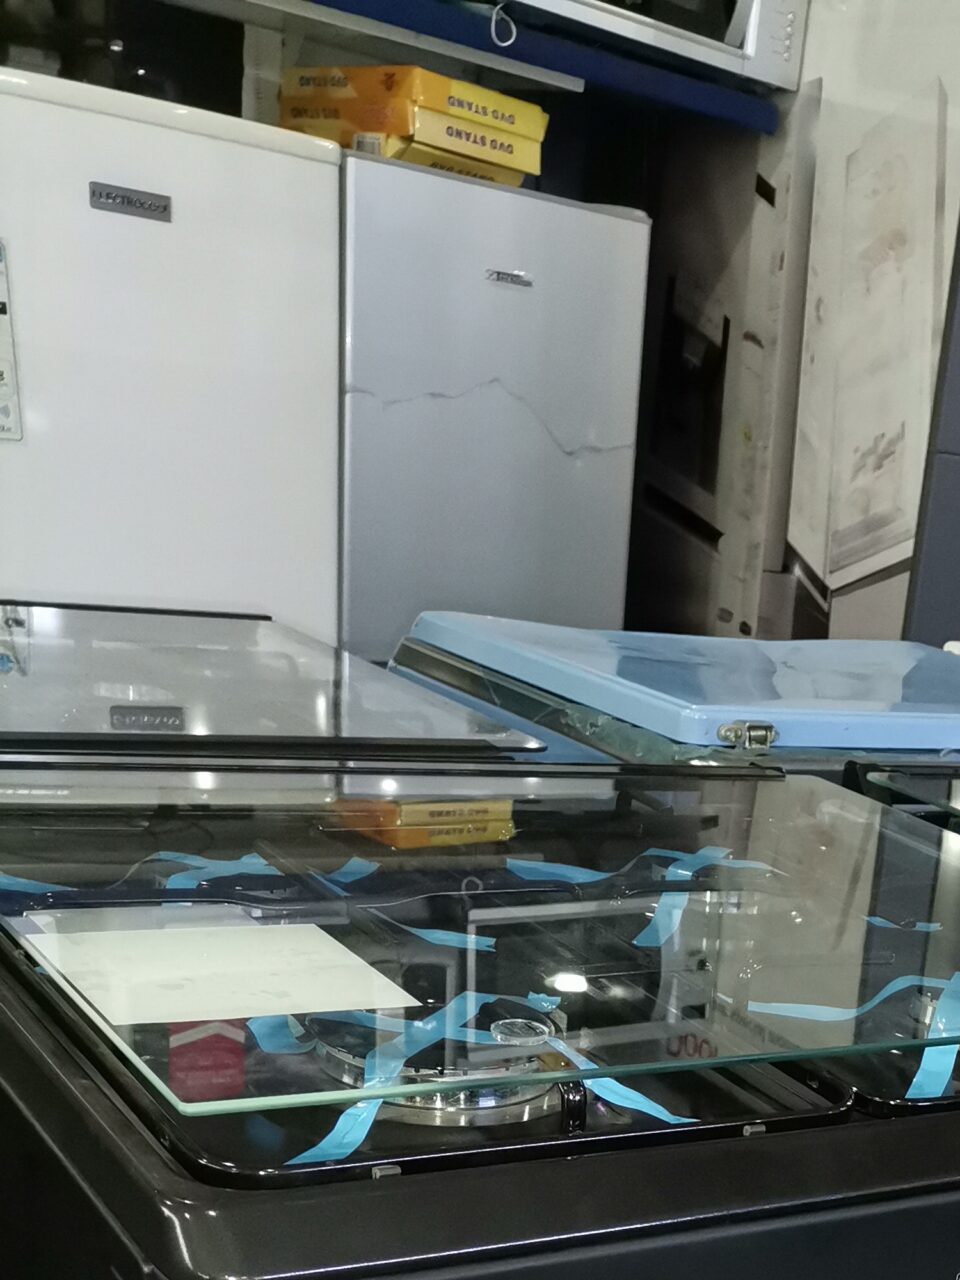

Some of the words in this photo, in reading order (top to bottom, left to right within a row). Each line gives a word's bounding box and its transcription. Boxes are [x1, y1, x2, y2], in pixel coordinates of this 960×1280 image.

[447, 95, 490, 118] STAND
[492, 108, 516, 125] DVD
[445, 125, 488, 147] STAND
[489, 138, 514, 155] DVD
